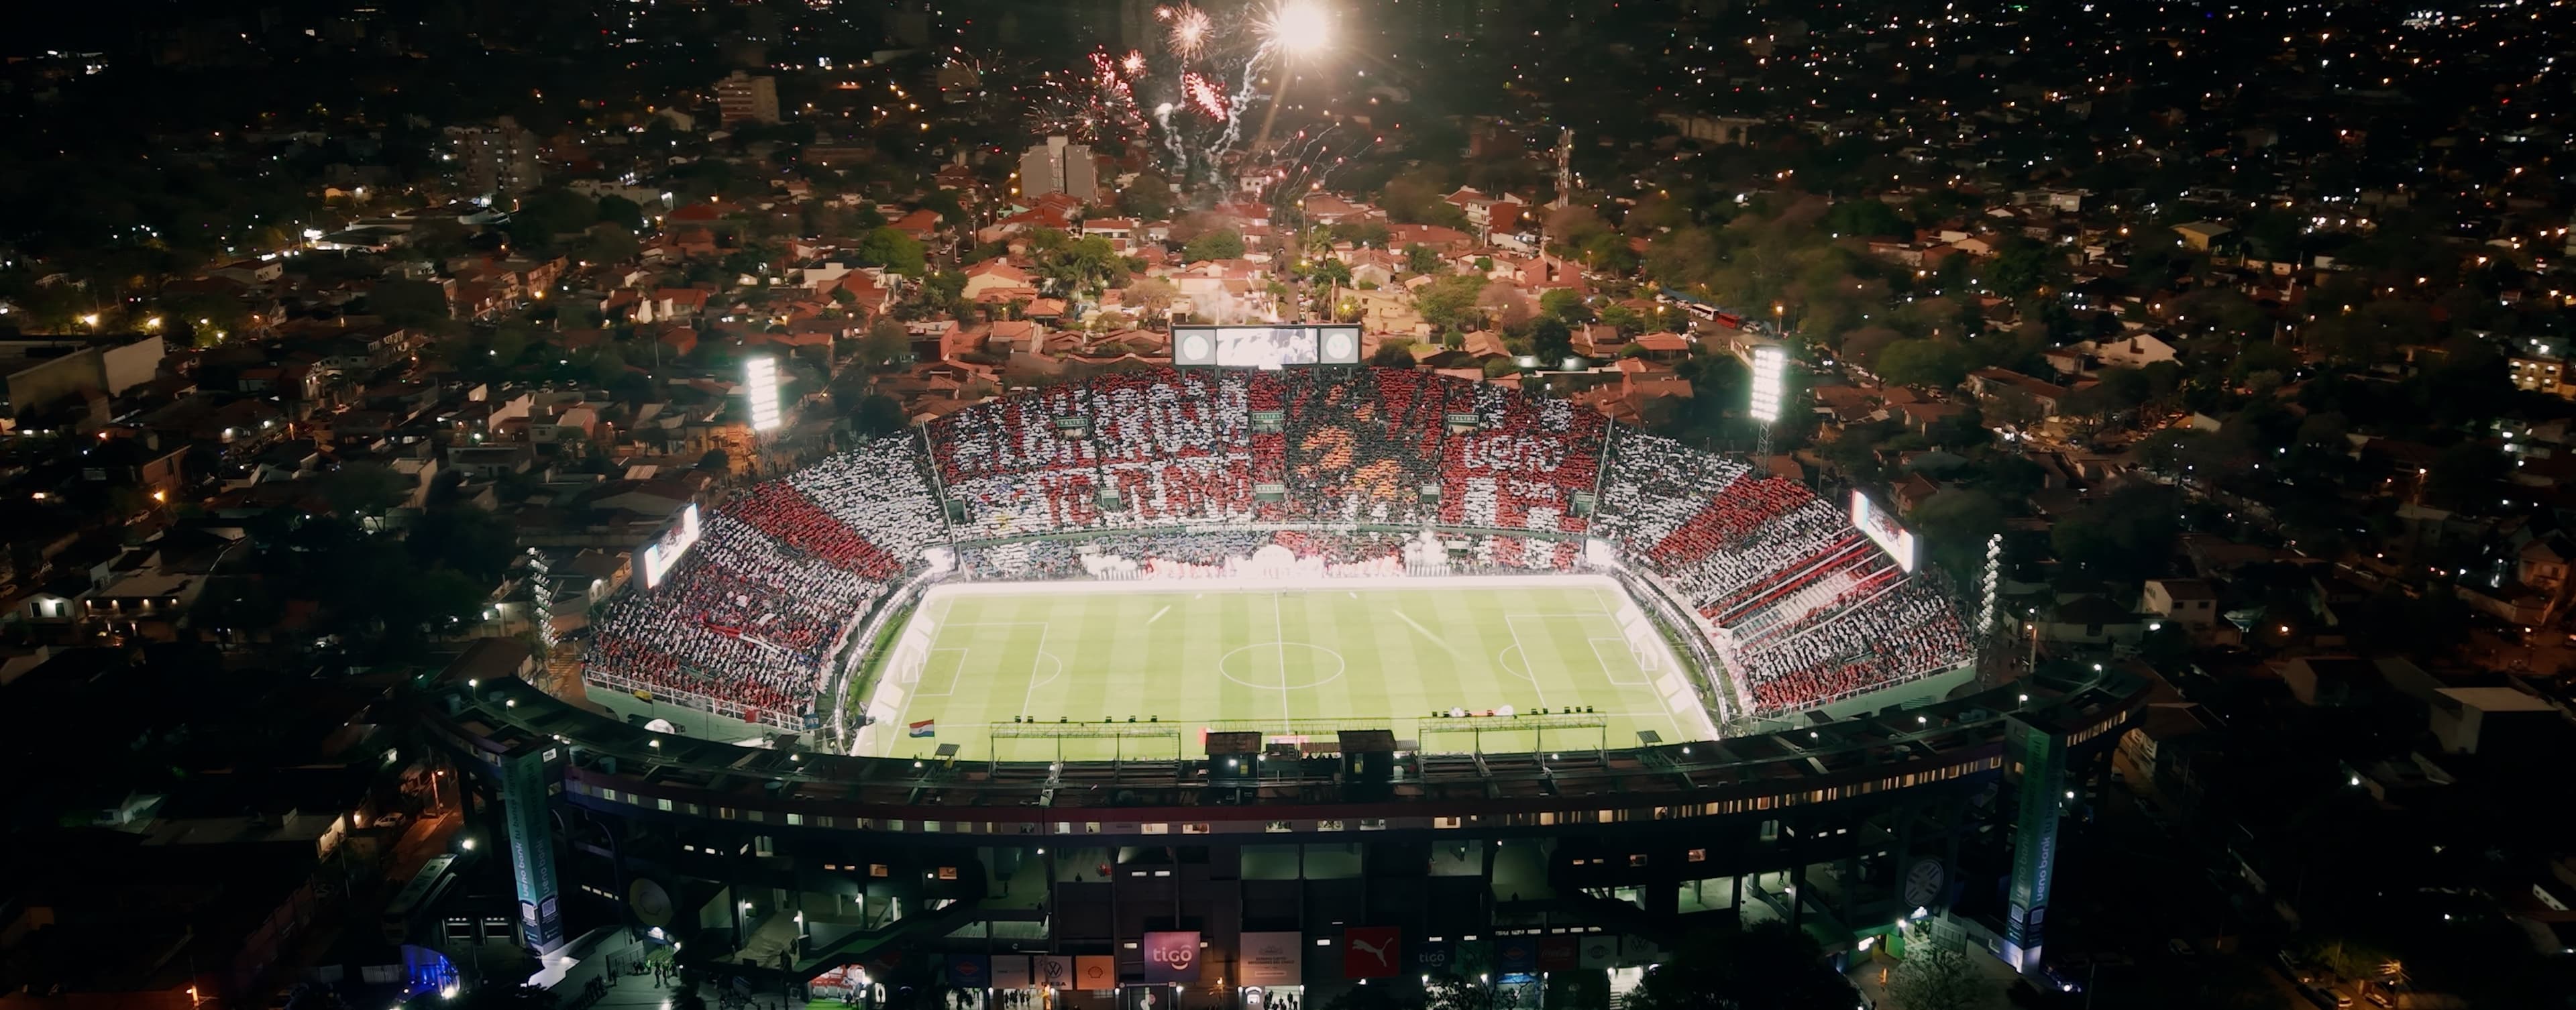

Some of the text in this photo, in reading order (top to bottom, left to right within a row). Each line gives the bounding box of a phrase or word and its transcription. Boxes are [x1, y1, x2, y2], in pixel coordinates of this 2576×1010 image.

[516, 842, 525, 868] bank
[535, 838, 546, 867] bank
[2019, 833, 2029, 864] bank
[2039, 837, 2051, 868] bank
[521, 871, 529, 897] ueno
[540, 867, 550, 894] ueno
[2016, 867, 2027, 898] ueno
[2036, 870, 2047, 901] ueno
[1152, 945, 1193, 970] tigo
[1419, 950, 1445, 967] tigo
